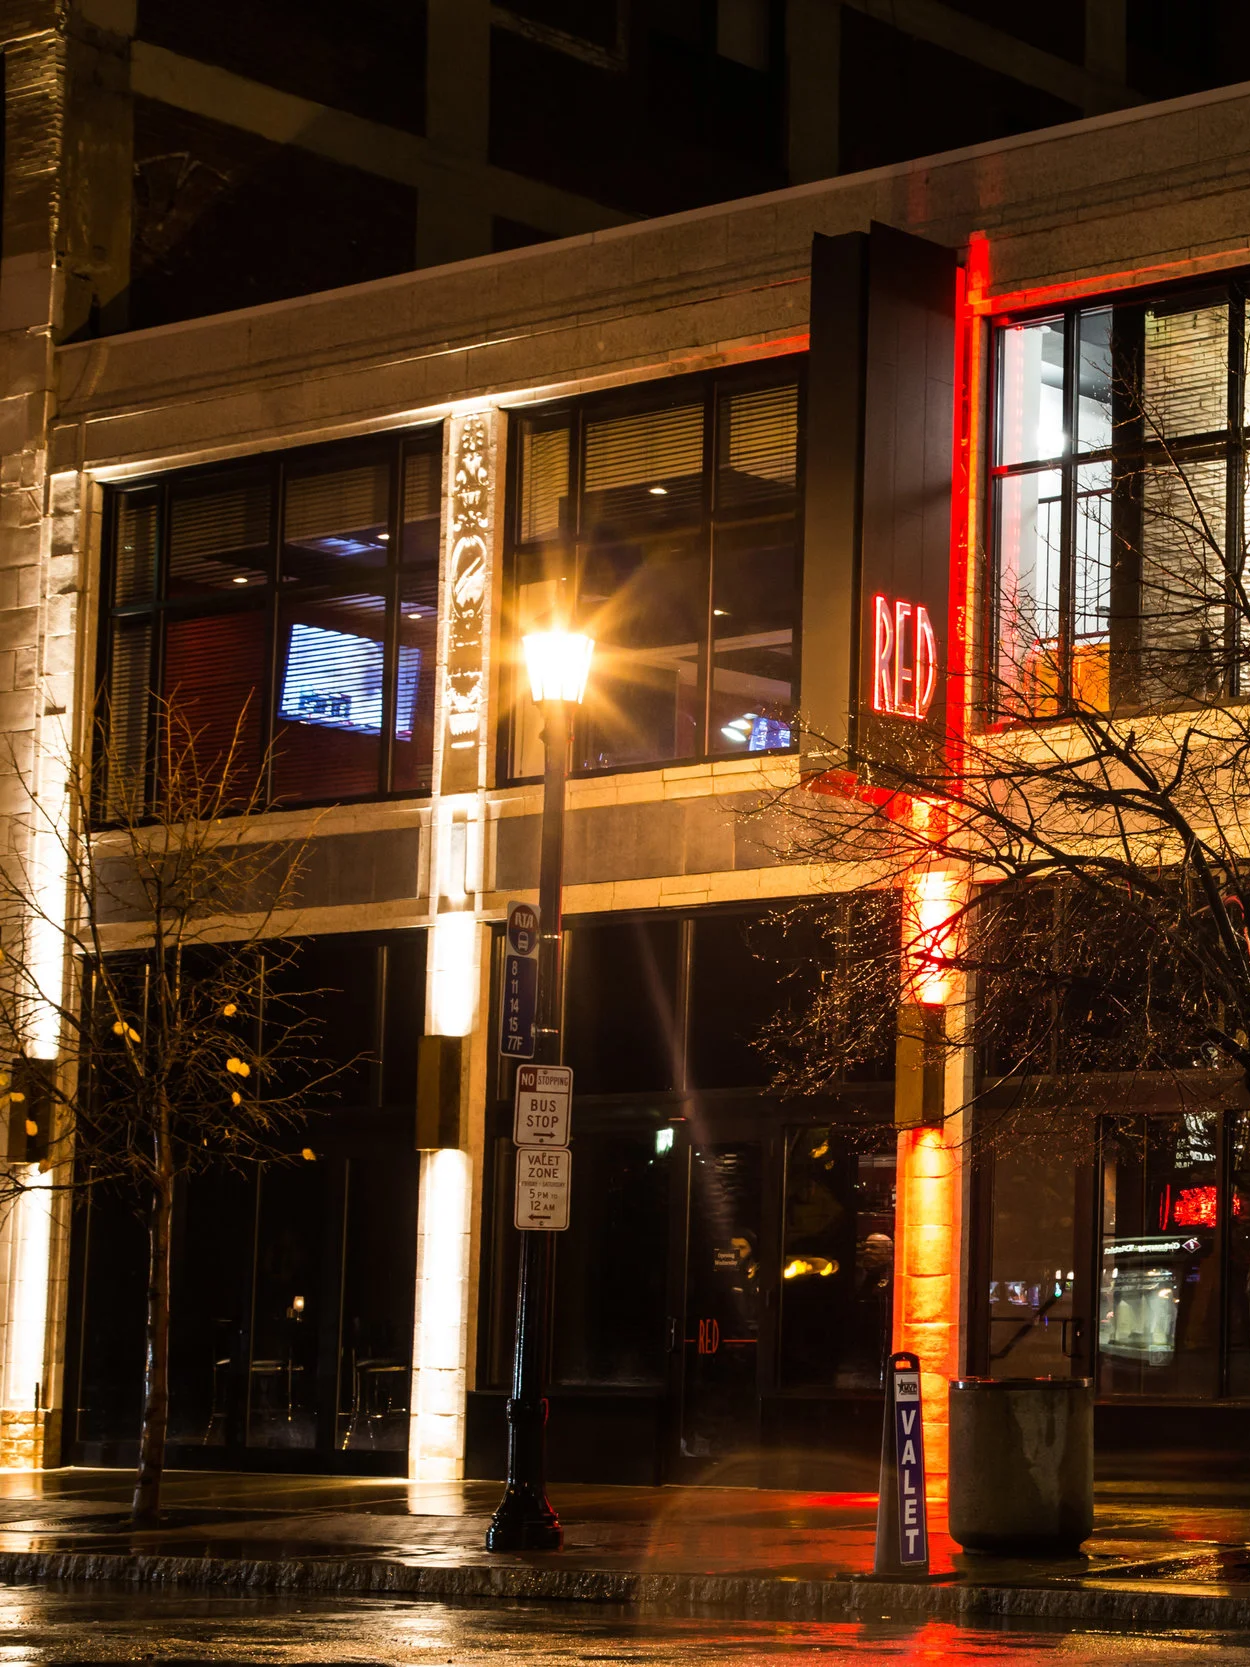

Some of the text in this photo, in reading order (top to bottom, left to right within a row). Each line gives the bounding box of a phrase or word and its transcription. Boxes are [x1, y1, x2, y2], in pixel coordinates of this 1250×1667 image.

[873, 596, 937, 720] RED
[514, 912, 534, 929] RTA
[511, 960, 518, 976] 8
[511, 979, 519, 994] 11
[510, 998, 519, 1013] 14
[509, 1016, 519, 1032] 15
[507, 1035, 523, 1051] 77F
[521, 1073, 569, 1087] NO STOPPING
[530, 1098, 557, 1112] BUS
[526, 1114, 559, 1128] STOP
[527, 1154, 561, 1166] VALET
[528, 1167, 559, 1179] ZONE
[529, 1188, 536, 1199] 5
[530, 1200, 555, 1211] 12 AM
[698, 1319, 720, 1354] RED
[900, 1409, 920, 1555] VALET
